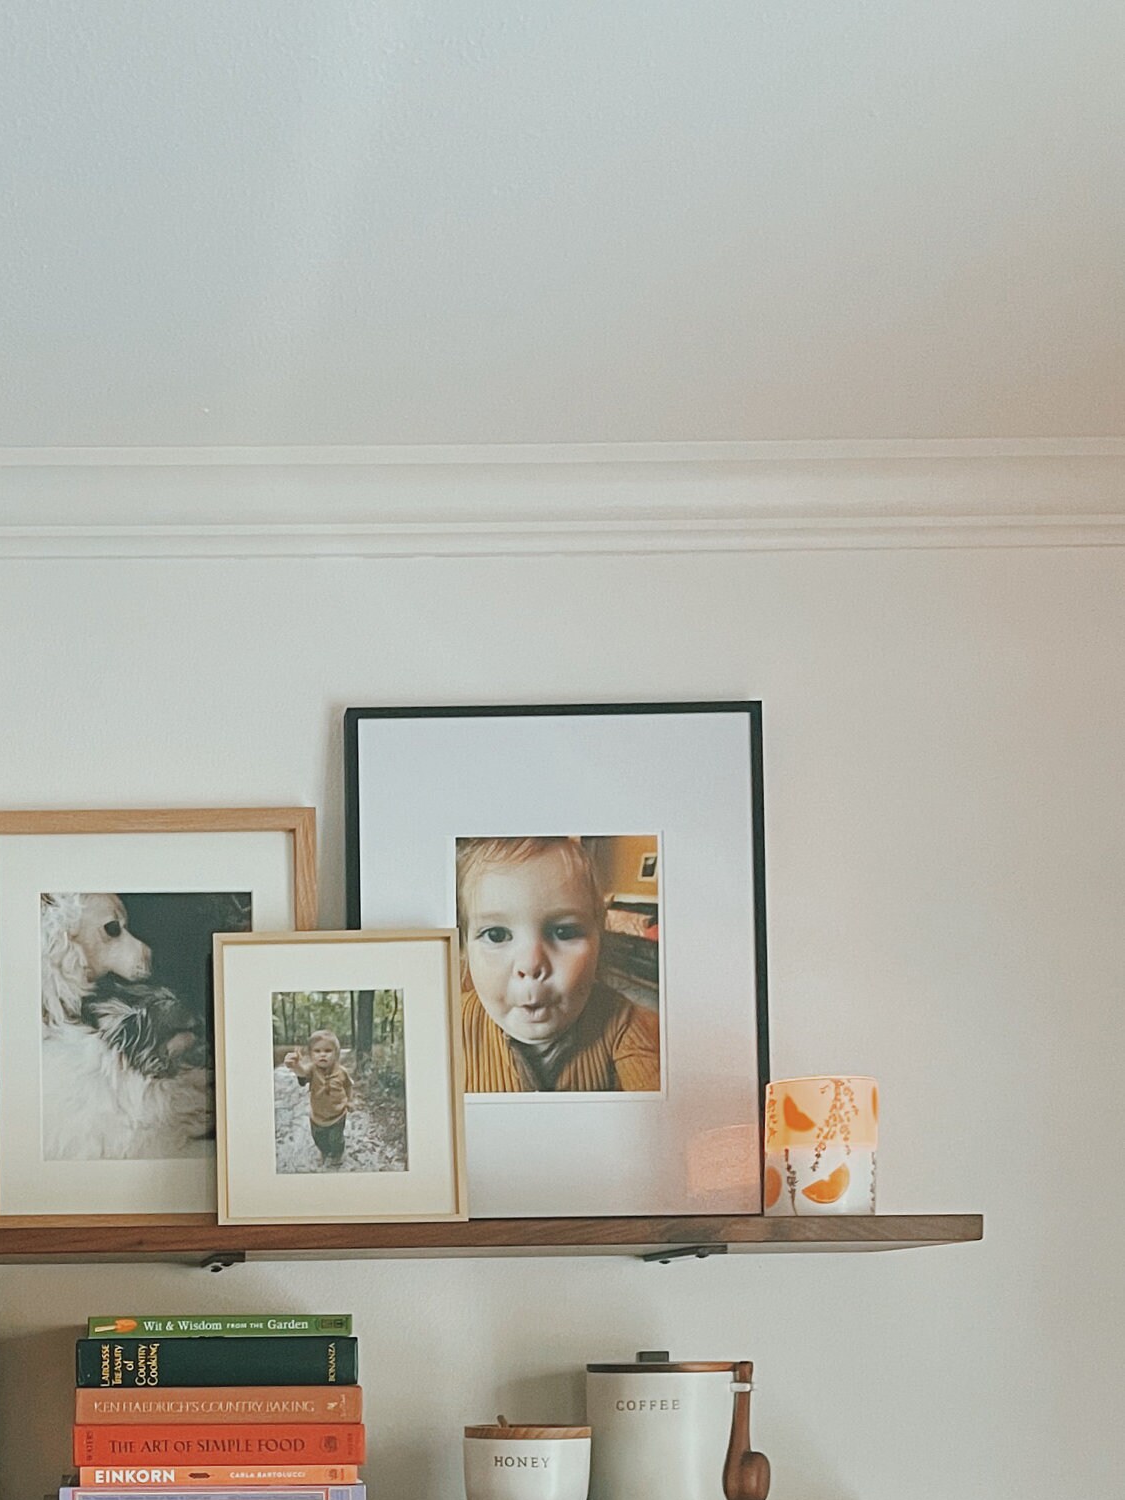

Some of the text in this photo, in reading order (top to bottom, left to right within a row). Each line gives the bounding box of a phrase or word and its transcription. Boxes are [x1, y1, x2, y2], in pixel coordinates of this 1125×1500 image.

[143, 1321, 162, 1331] Wit
[165, 1321, 174, 1331] &
[178, 1320, 222, 1331] Wisdom
[267, 1319, 308, 1330] Garden
[328, 1342, 336, 1382] BONANZA
[94, 1401, 120, 1413] KEN
[201, 1401, 263, 1413] COUNTRY
[266, 1400, 315, 1413] BAKING
[615, 1399, 681, 1411] COFFEE
[108, 1438, 305, 1453] THE ART OF SIMPLE FOOD
[493, 1455, 551, 1468] HONEY
[95, 1469, 175, 1483] EINKORN
